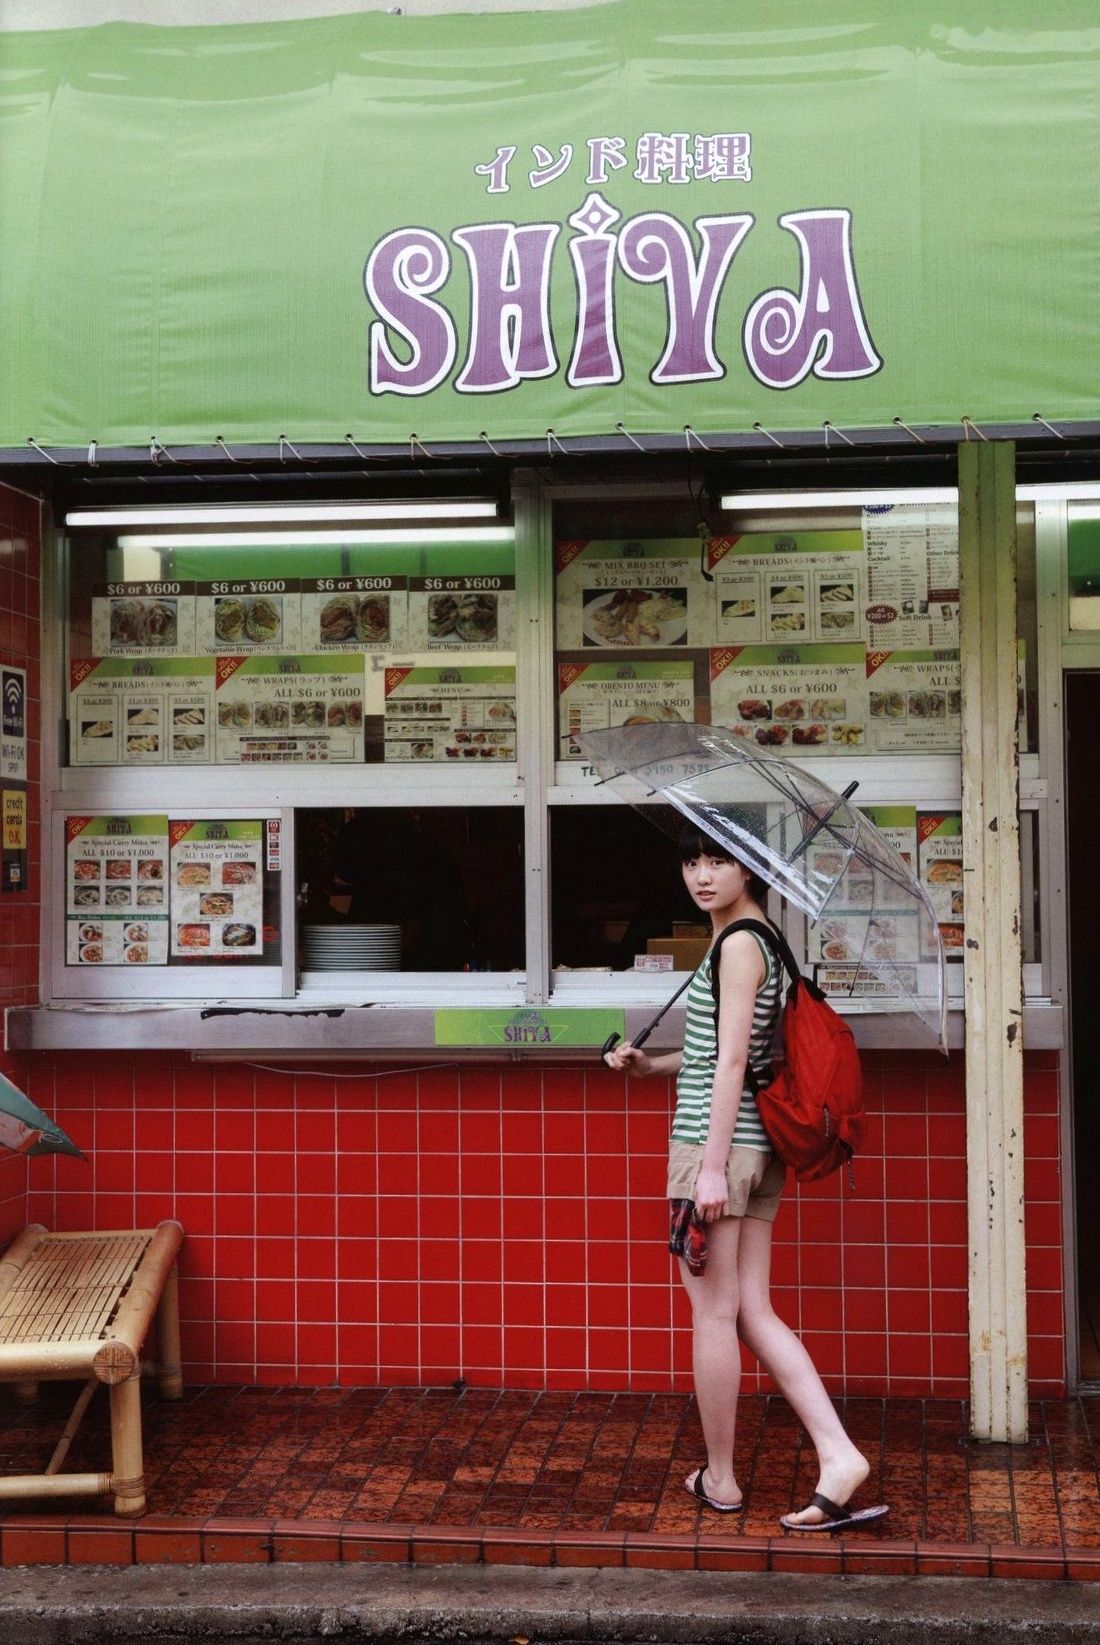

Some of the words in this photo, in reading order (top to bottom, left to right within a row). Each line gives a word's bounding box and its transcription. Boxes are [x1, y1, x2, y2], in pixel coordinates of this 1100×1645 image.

[475, 132, 752, 194] インド料理
[604, 562, 625, 570] MIX
[316, 579, 334, 590] $6
[338, 580, 352, 590] or
[355, 578, 392, 589] ¥600
[424, 579, 442, 590] $6
[446, 580, 461, 590] or
[464, 577, 501, 589] ¥600
[595, 577, 618, 586] $12
[621, 578, 632, 586] or
[107, 584, 124, 595] $6
[128, 585, 142, 594] or
[145, 583, 180, 594] ¥600
[211, 582, 229, 594] $6
[232, 583, 247, 593] or
[250, 581, 286, 592] ¥600
[929, 678, 951, 686] ALL
[274, 689, 293, 698] ALL
[298, 688, 313, 697] $6
[330, 688, 361, 697] ¥600
[746, 685, 767, 694] ALL
[771, 684, 786, 693] $6
[805, 683, 837, 693] ¥600
[612, 700, 631, 708] ALL
[634, 699, 647, 708] $8
[663, 699, 690, 707] ¥800
[6, 797, 23, 809] credit
[6, 814, 22, 825] cards
[82, 849, 96, 857] ALL
[100, 849, 115, 857] $10
